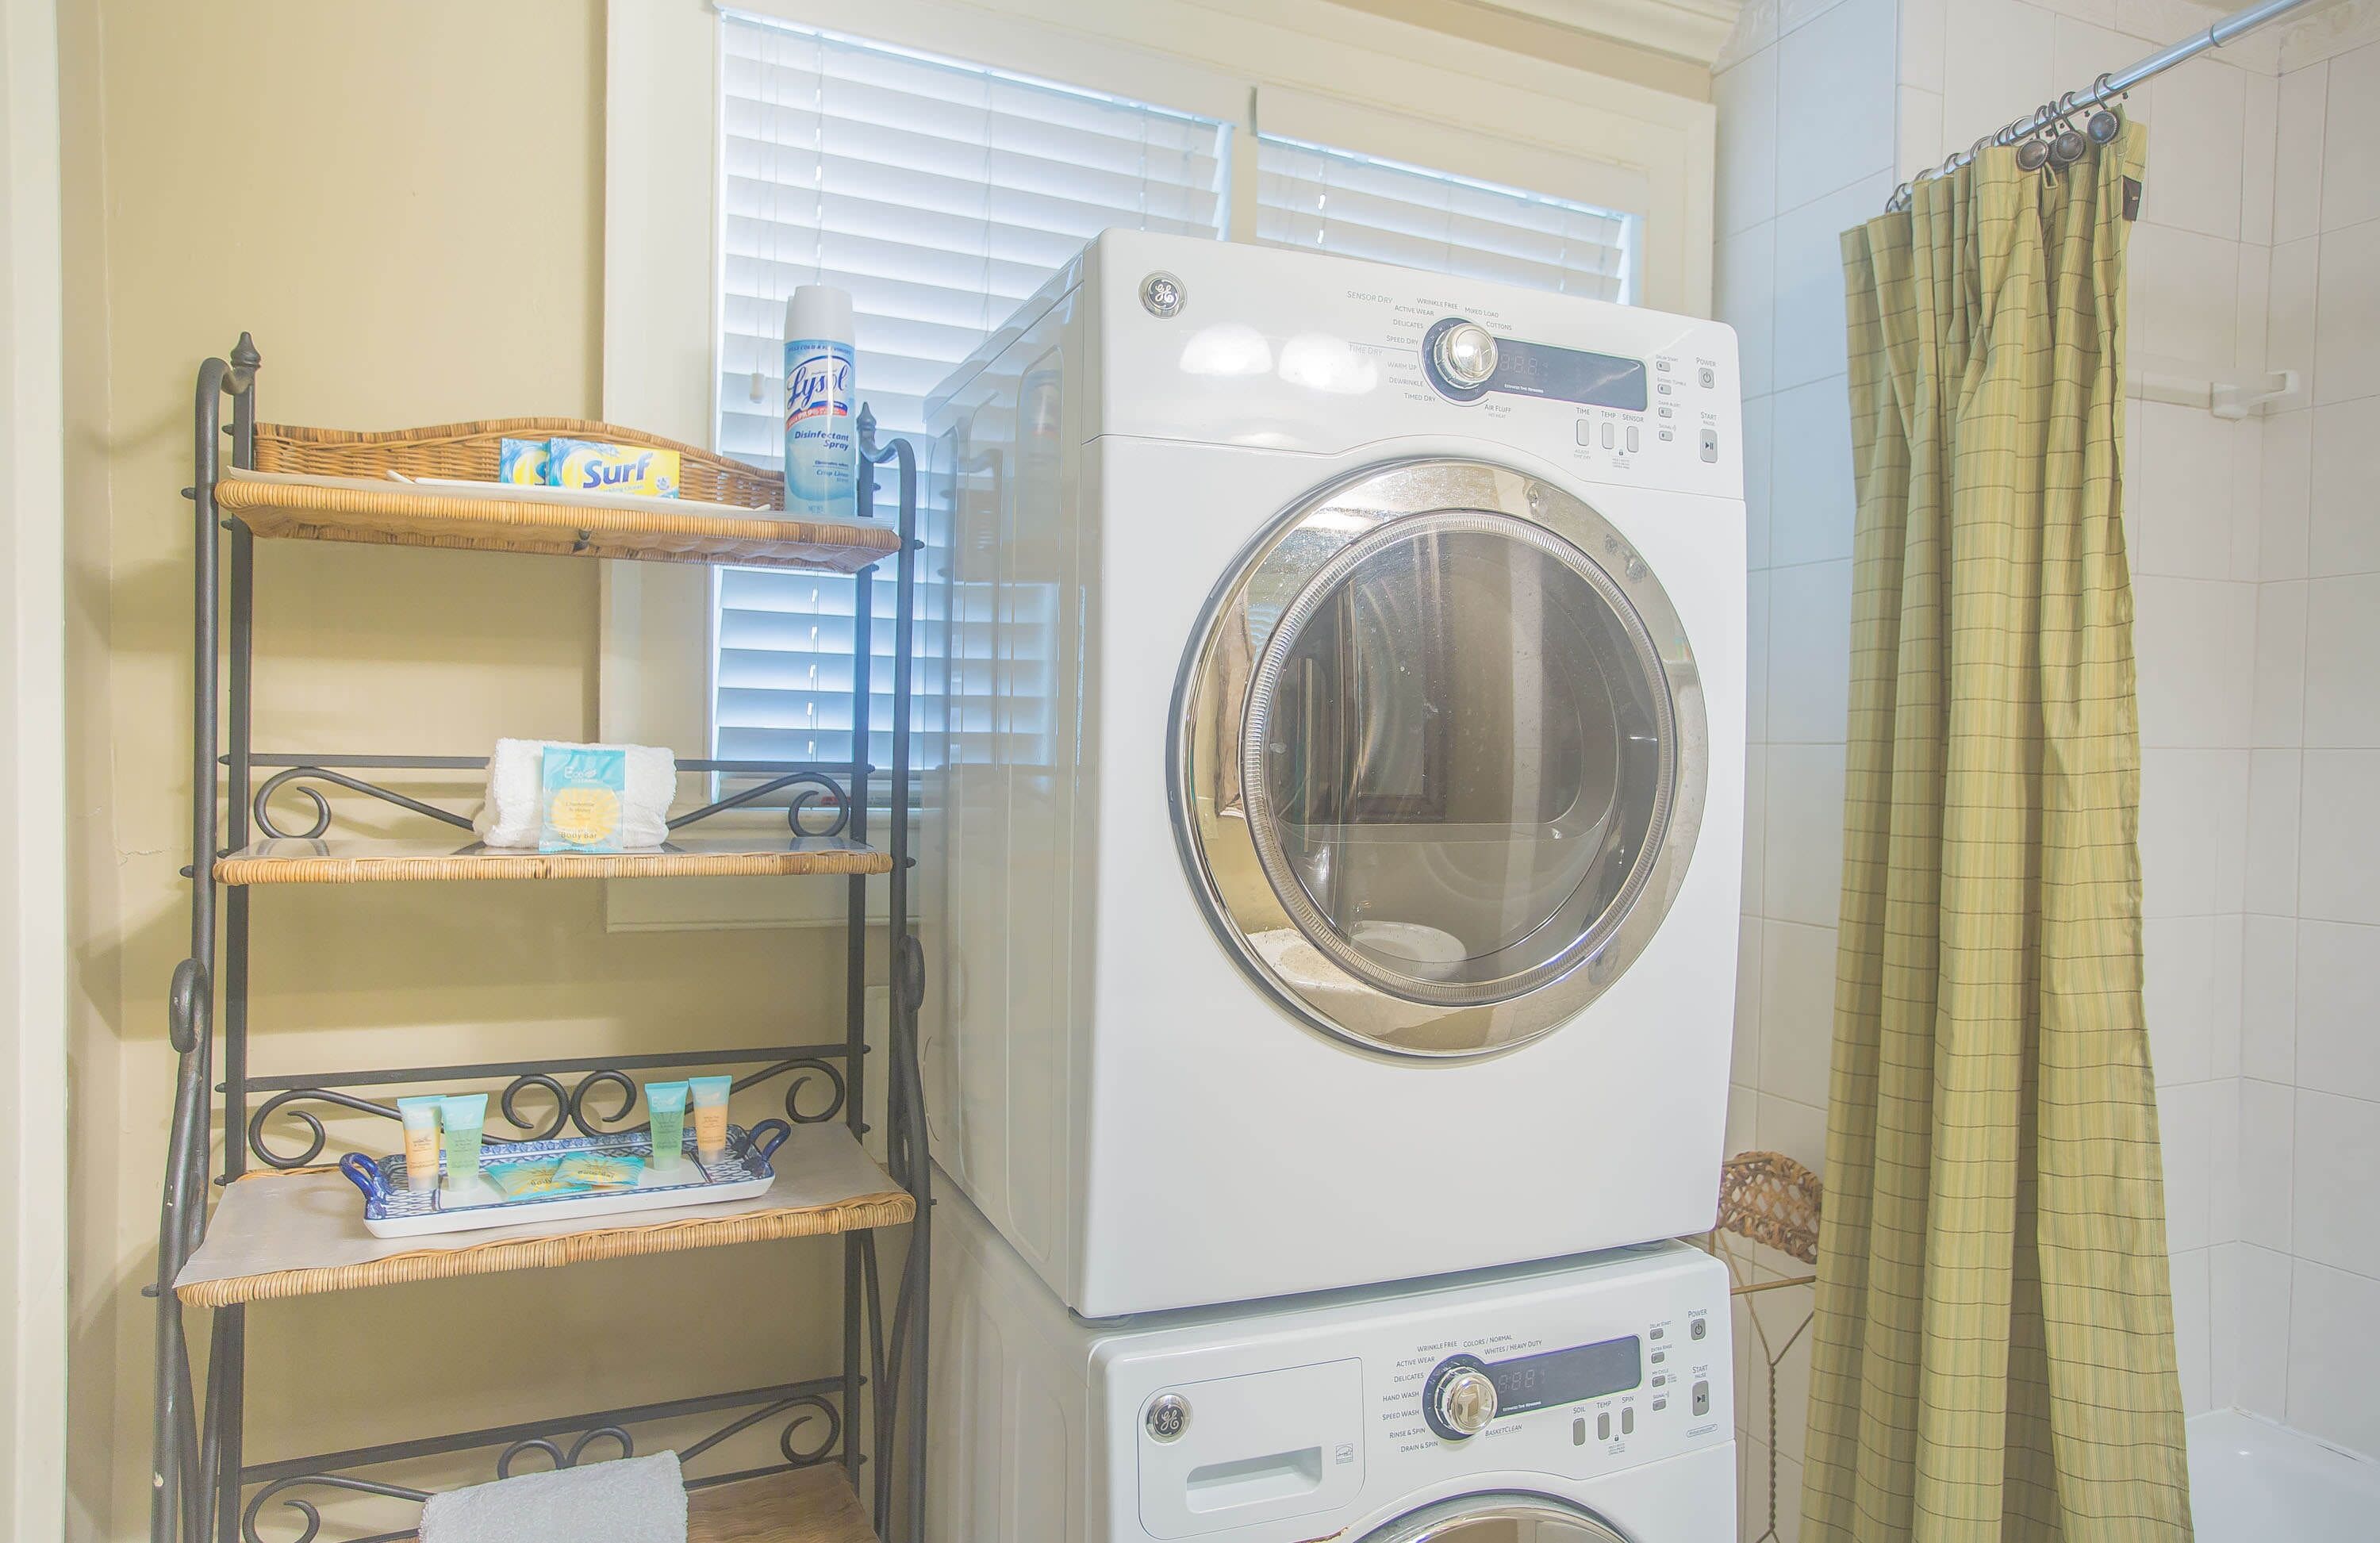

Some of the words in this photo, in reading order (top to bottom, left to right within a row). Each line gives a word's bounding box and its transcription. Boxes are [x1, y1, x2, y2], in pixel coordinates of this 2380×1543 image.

[1347, 290, 1376, 301] SENSOR
[1377, 294, 1392, 304] DRY
[1417, 297, 1443, 307] WRINKLE
[1395, 305, 1416, 314] ACTIVE
[1416, 308, 1434, 317] WEAR
[1464, 306, 1483, 316] MIXED
[1392, 318, 1423, 329] DELICATES
[1486, 320, 1512, 331] COTTONS
[1386, 335, 1405, 344] SPEED
[1349, 344, 1366, 354] TIME
[1368, 346, 1384, 356] DRY
[1387, 361, 1407, 370] WARM
[1696, 357, 1716, 367] POWER
[787, 364, 848, 409] Lysol
[1388, 376, 1424, 387] DEWRINKLE
[1403, 392, 1422, 401] TIMED
[1622, 413, 1645, 423] SENSOR
[1700, 412, 1717, 420] START
[794, 430, 849, 442] Disinfectant
[823, 439, 849, 451] Spray
[583, 451, 653, 489] Surf
[1687, 1309, 1708, 1318] POWER
[1417, 1341, 1443, 1352] WRINKLE
[1444, 1340, 1457, 1349] FREE
[1463, 1338, 1485, 1348] COLORS
[1489, 1334, 1512, 1343] NORMAL
[1484, 1346, 1506, 1355] WHITES
[1509, 1342, 1527, 1351] HEAVY
[1527, 1339, 1542, 1348] DUTY
[1692, 1365, 1708, 1373] START
[1394, 1372, 1424, 1383] DELICATES
[1383, 1393, 1400, 1403] HAND
[1401, 1391, 1419, 1399] WASH
[1382, 1412, 1400, 1421] SPEED
[1401, 1409, 1419, 1418] WASH
[1389, 1430, 1407, 1439] RINSE
[1484, 1424, 1522, 1437] BASKETCLEAN
